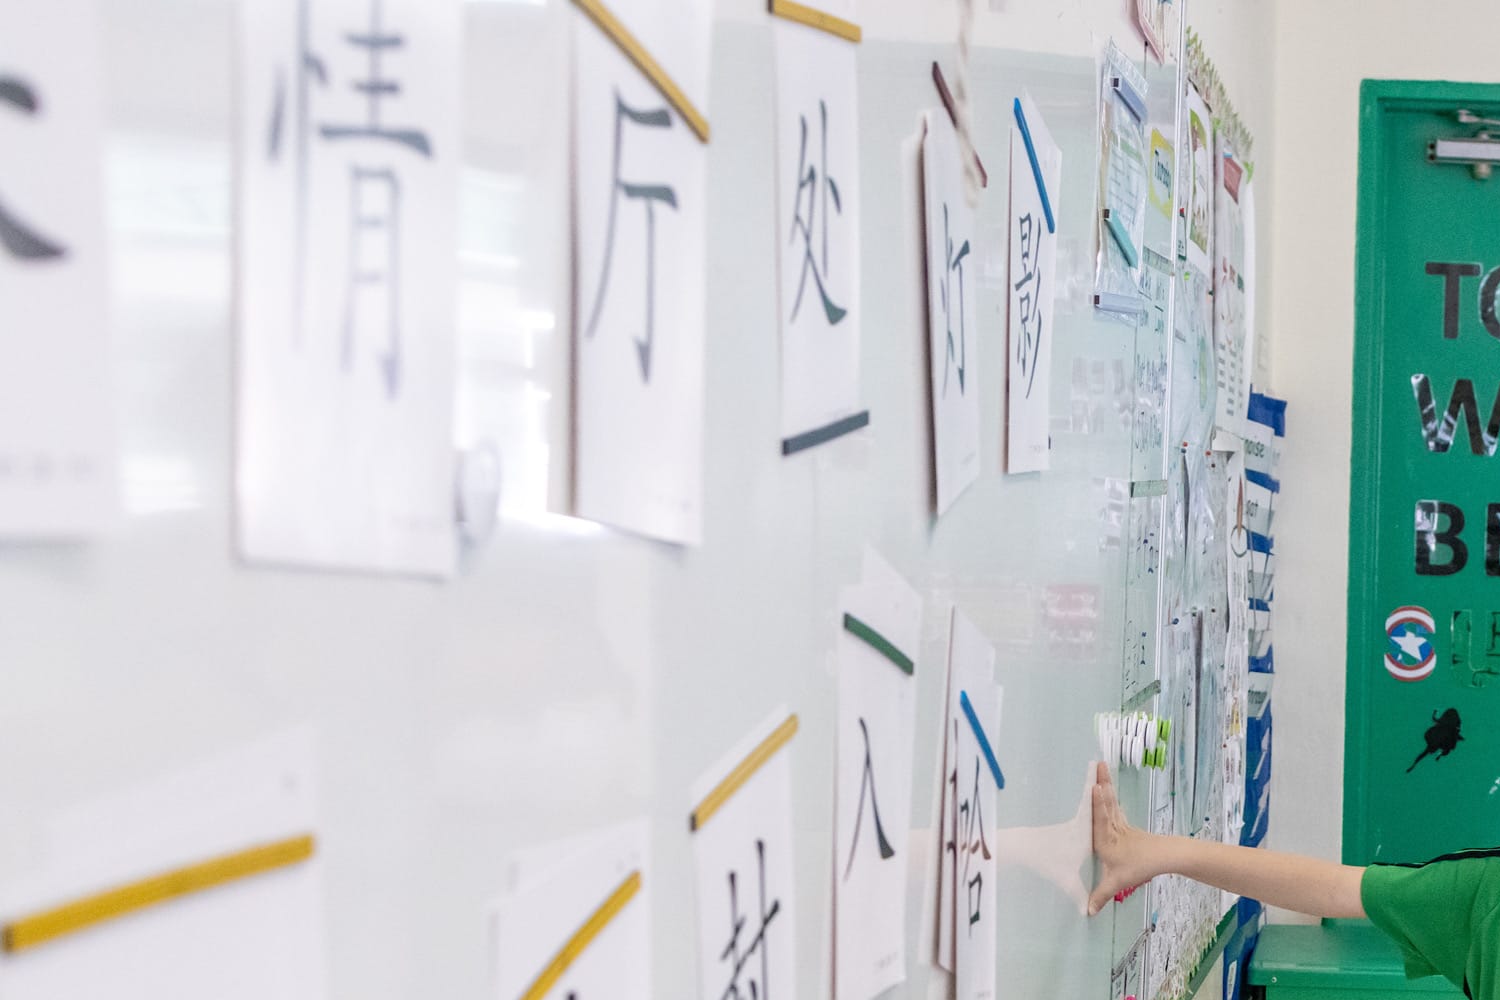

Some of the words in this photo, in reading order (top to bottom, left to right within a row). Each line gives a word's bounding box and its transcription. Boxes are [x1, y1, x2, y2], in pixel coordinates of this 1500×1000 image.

[586, 84, 680, 385] 厅
[789, 99, 848, 326] 处
[939, 202, 971, 399] 灯
[1014, 211, 1043, 399] 影
[842, 716, 896, 884] 人
